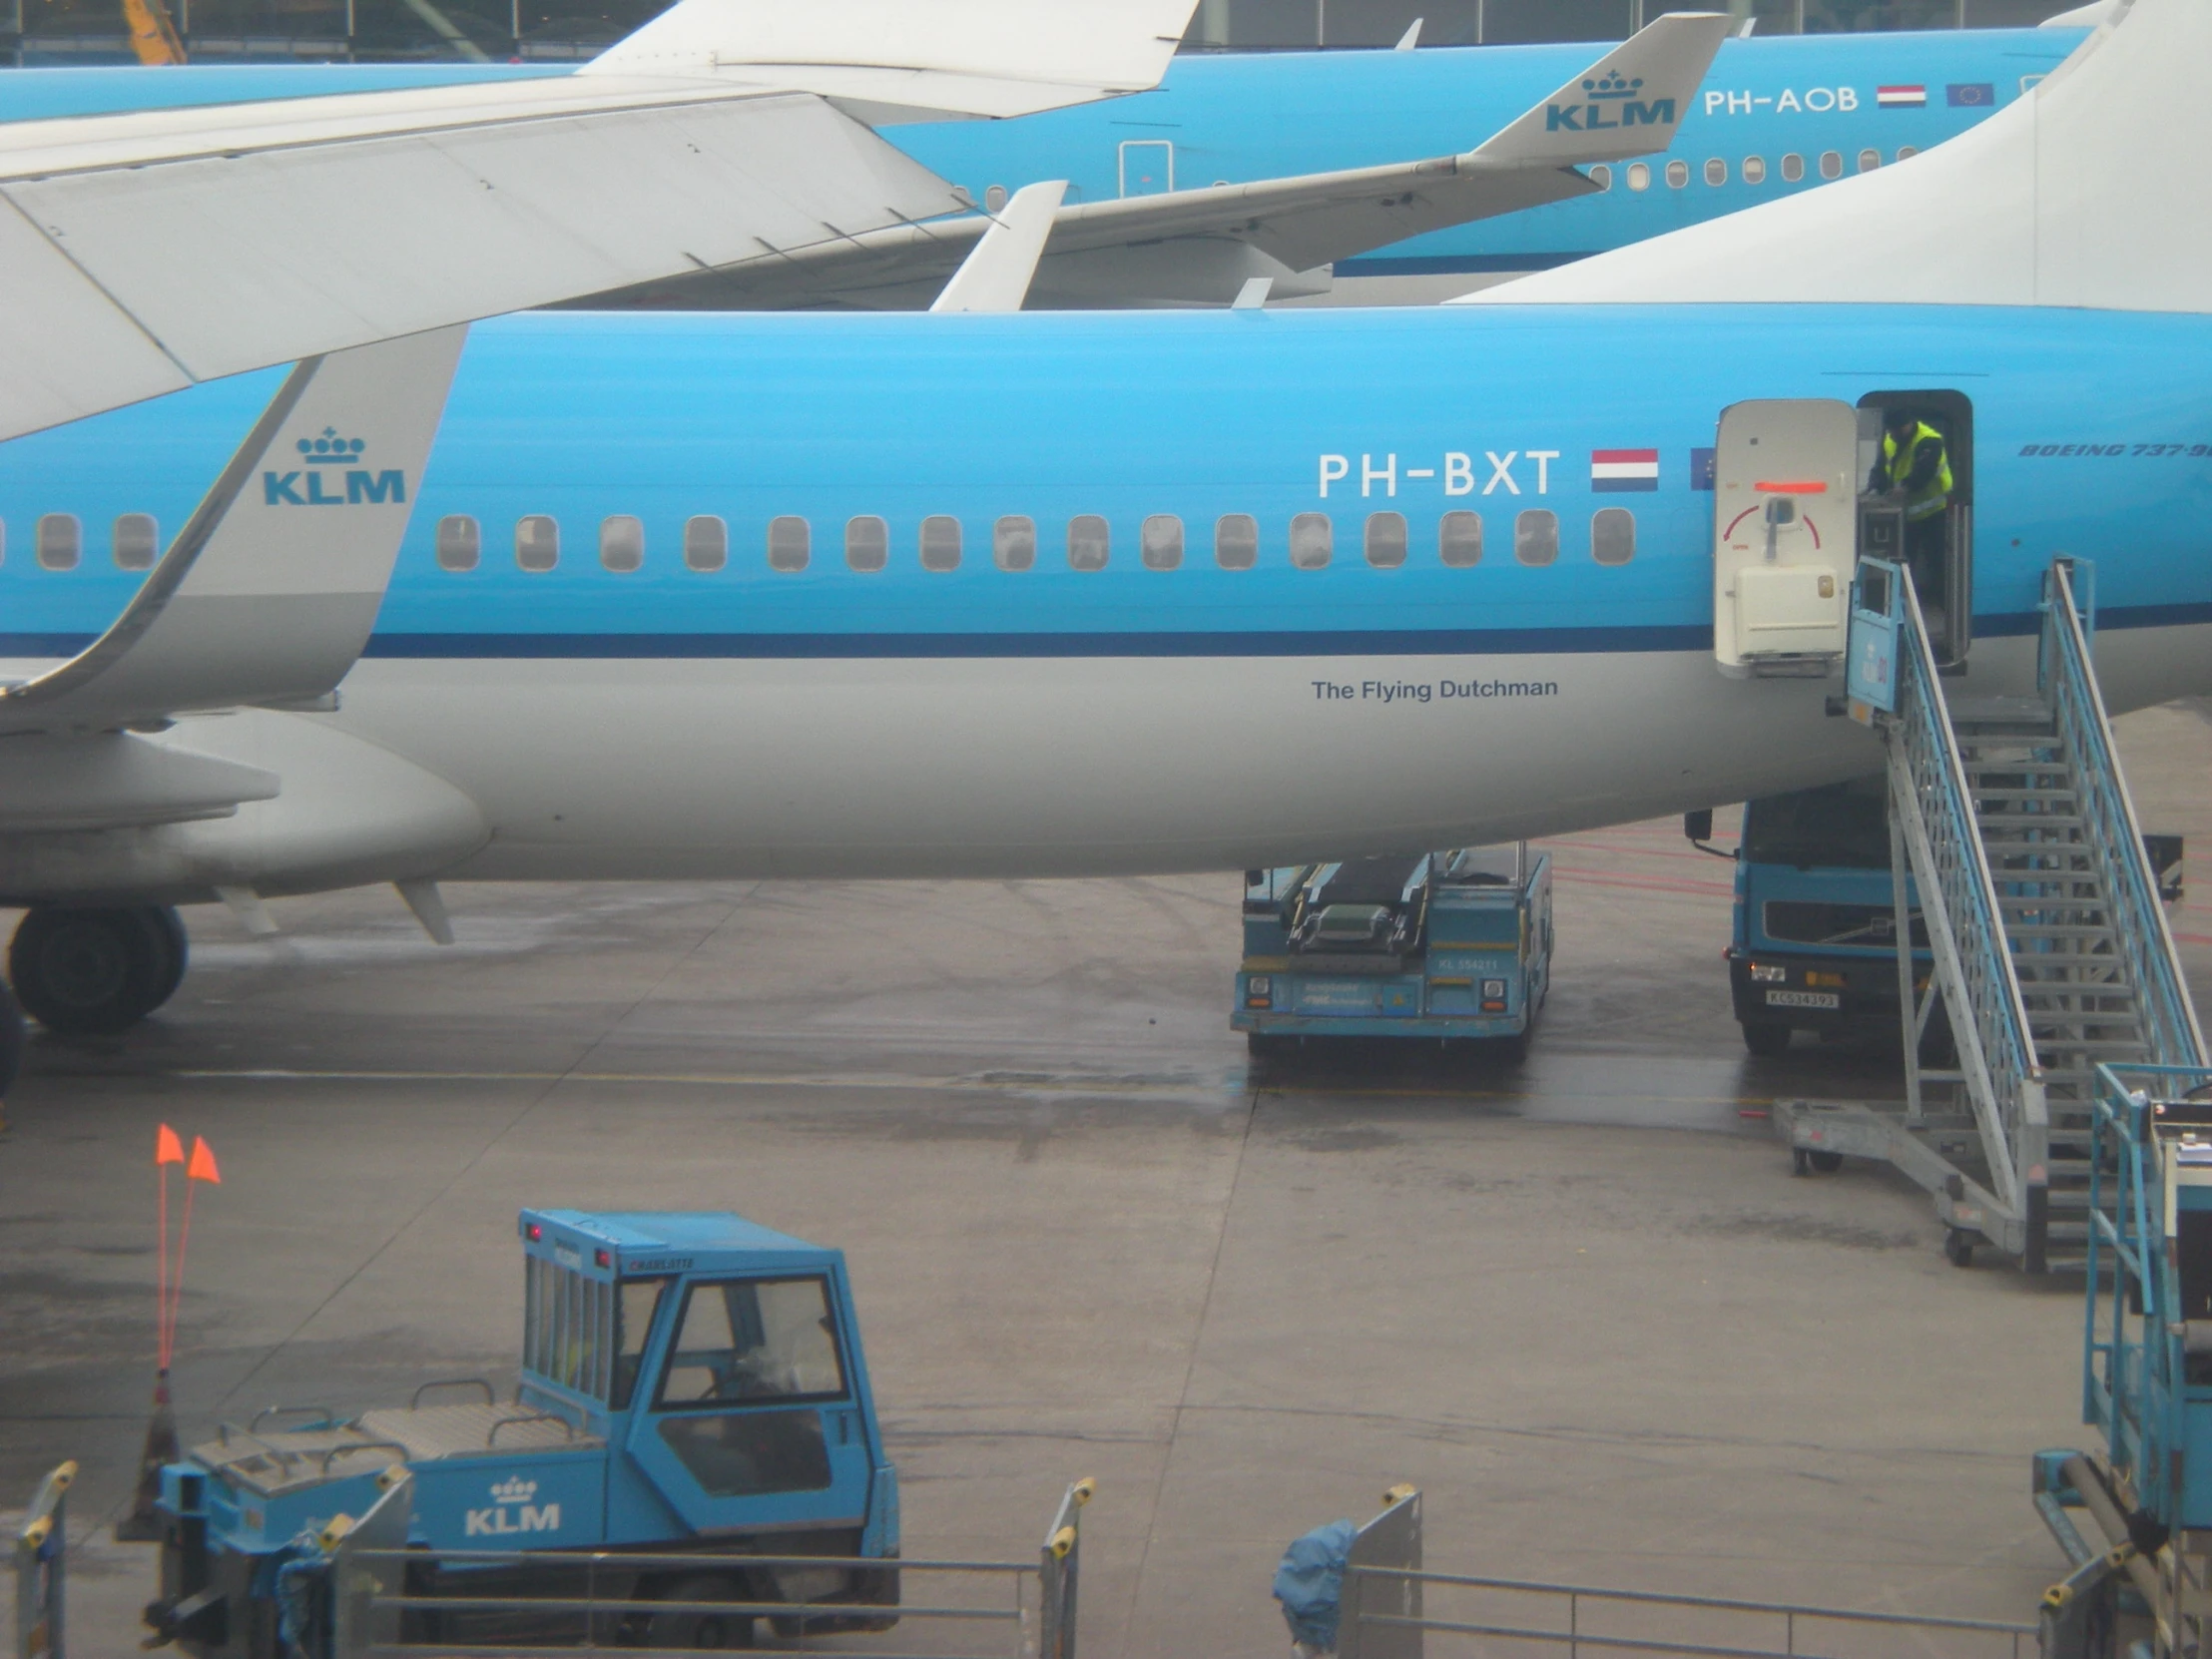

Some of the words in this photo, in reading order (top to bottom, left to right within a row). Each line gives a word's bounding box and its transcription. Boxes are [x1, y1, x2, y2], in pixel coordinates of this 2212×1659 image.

[1546, 98, 1675, 132] KLM
[1705, 87, 1859, 116] PH-AOB
[2018, 444, 2127, 456] BOEING
[264, 469, 405, 506] KLM
[1319, 450, 1560, 498] PH-BXT
[1312, 681, 1355, 699] The
[1361, 681, 1431, 703] Flying
[1439, 679, 1558, 698] Dutchman
[1438, 958, 1454, 970] KL
[465, 1503, 560, 1535] KLM
